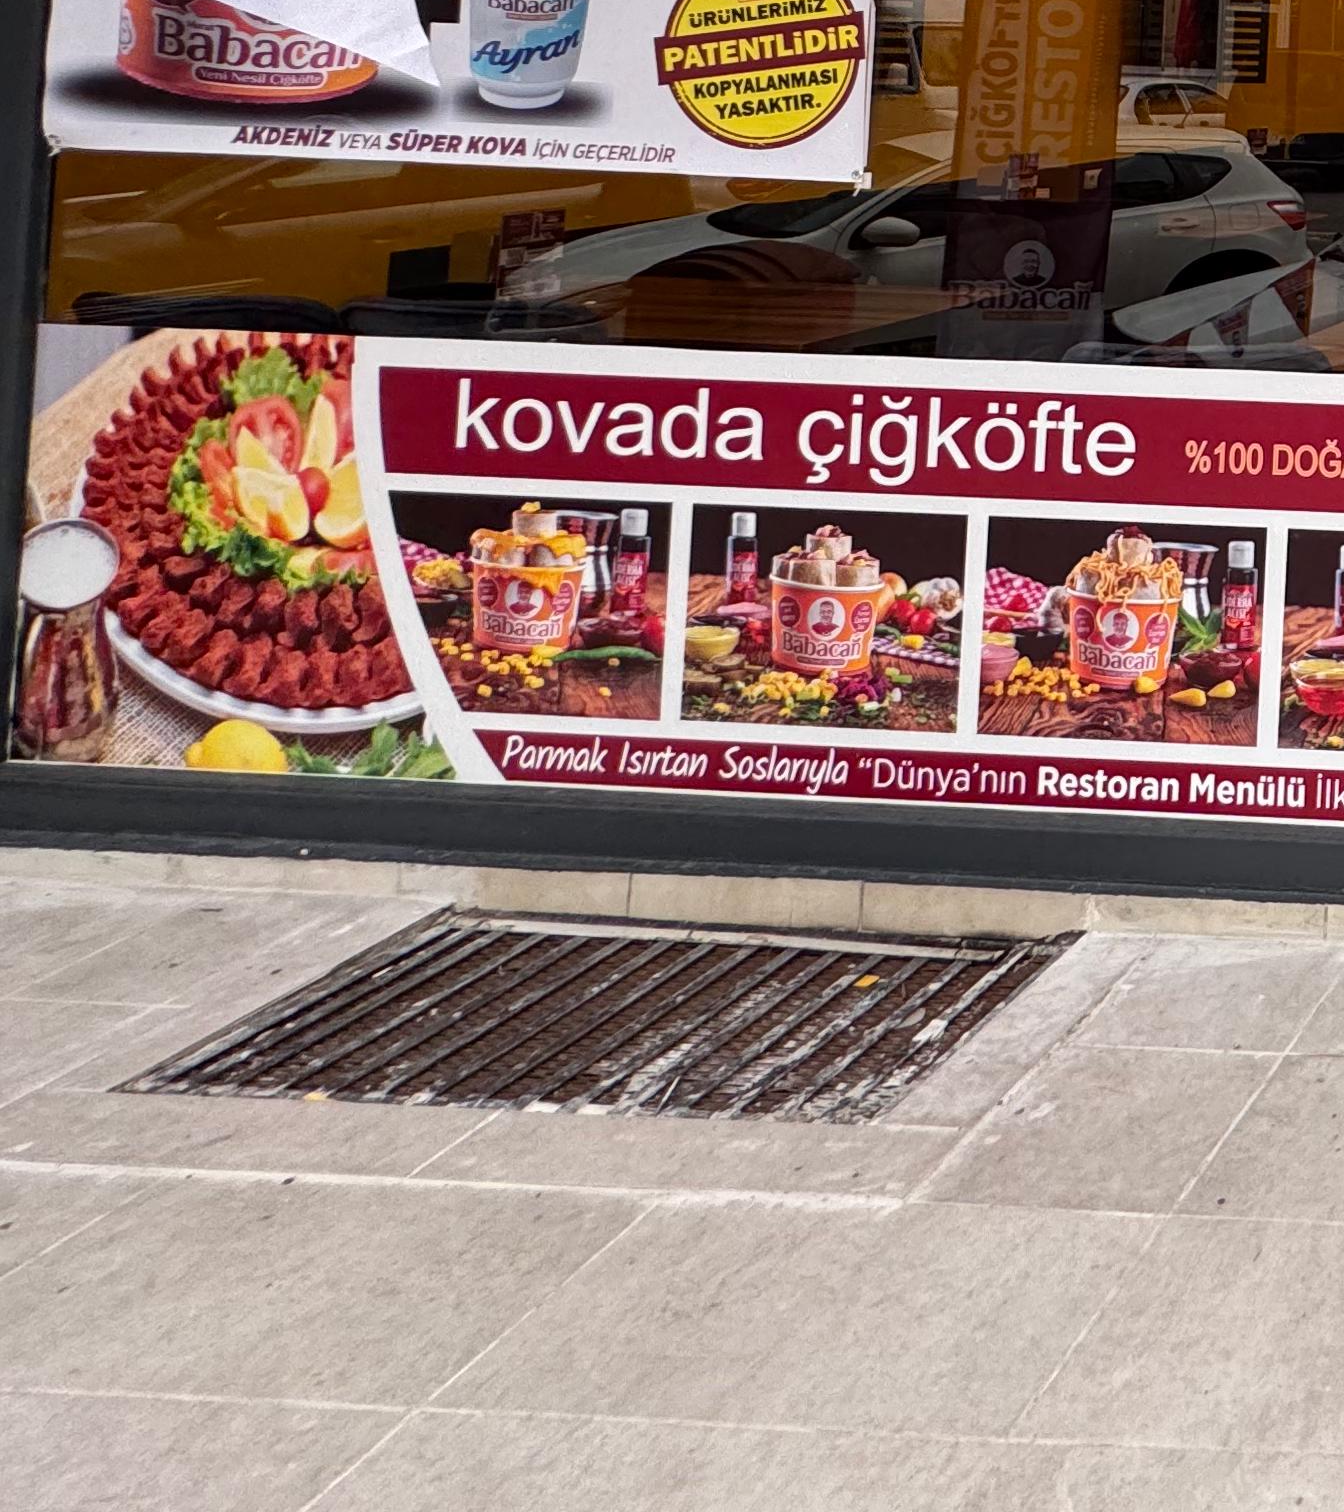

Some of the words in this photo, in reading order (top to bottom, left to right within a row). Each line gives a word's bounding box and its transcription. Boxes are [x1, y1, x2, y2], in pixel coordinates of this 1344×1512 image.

[472, 29, 582, 74] Ayran
[693, 69, 838, 100] KOPYALANMASI
[715, 94, 822, 120] YASAKTIR.
[232, 125, 334, 149] AKDENİZ
[338, 133, 382, 151] VEYA
[386, 129, 461, 154] SÜPER
[466, 136, 528, 157] KOVA
[533, 139, 568, 160] İÇİN
[573, 142, 676, 164] GEÇERLİDİR
[455, 377, 764, 461] kovada
[795, 393, 1137, 487] çiğköfte
[1185, 442, 1264, 477] %100
[501, 734, 606, 774] Parmak
[618, 740, 708, 778] Isırtan
[718, 745, 849, 796] Soslarıyla
[1038, 765, 1179, 804] Restoran
[1189, 772, 1305, 809] Menülü
